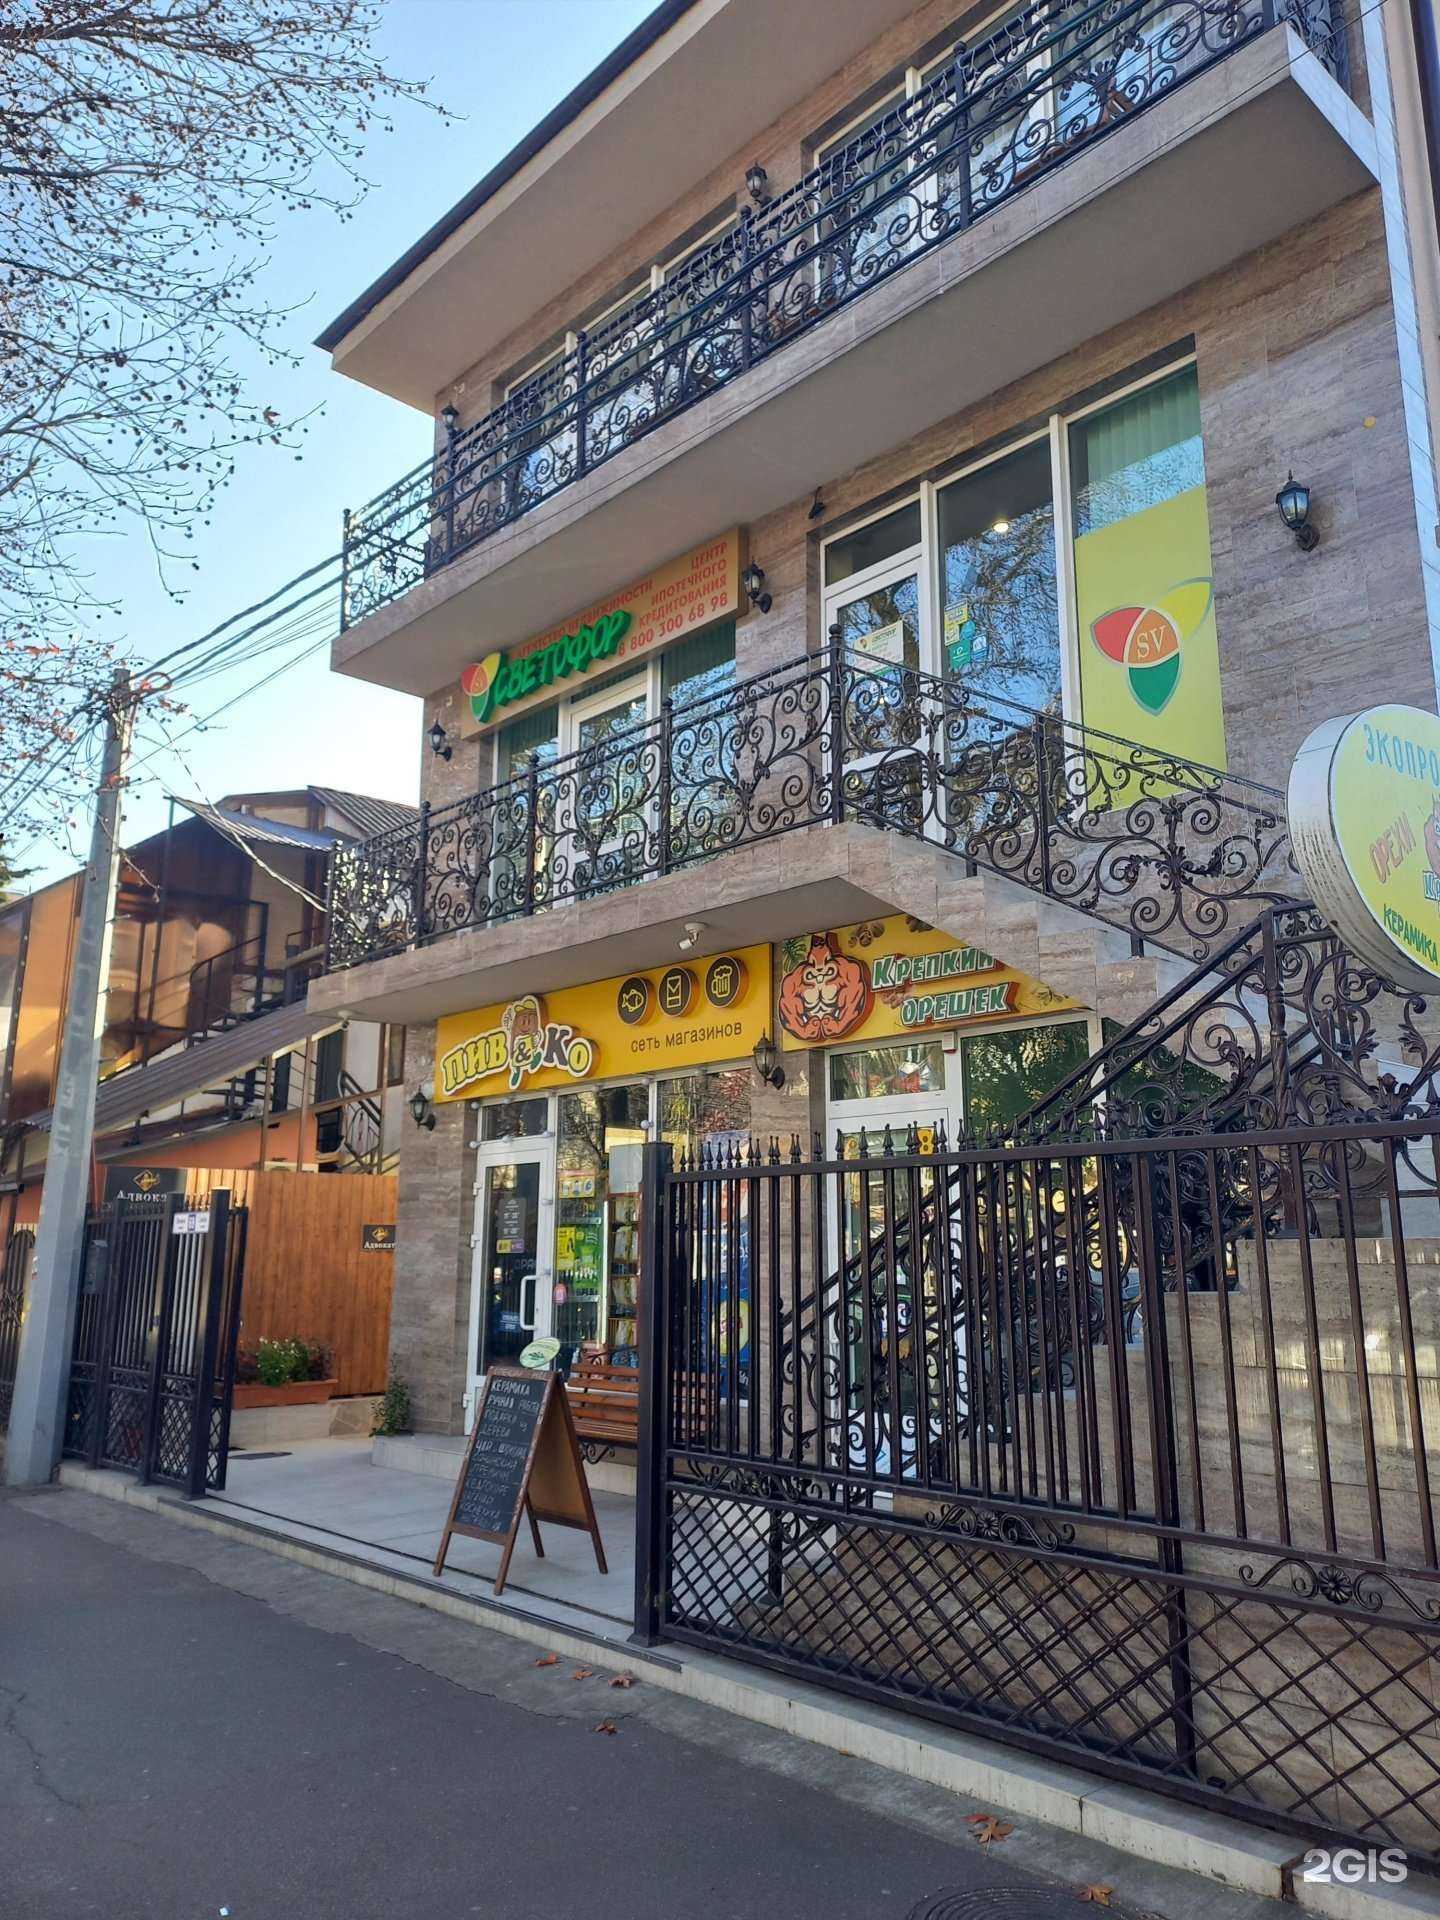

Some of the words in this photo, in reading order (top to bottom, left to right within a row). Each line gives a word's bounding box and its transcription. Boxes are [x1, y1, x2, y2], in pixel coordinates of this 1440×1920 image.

[691, 542, 728, 570] ЦЕНТР
[639, 575, 728, 629] КРЕДИТОВАНИЯ
[651, 559, 727, 606] ИПОТЕЧНОГО
[618, 642, 626, 657] 8
[630, 628, 655, 650] 800
[658, 614, 683, 637] 300
[688, 602, 705, 622] 68
[711, 592, 728, 612] 98
[1136, 625, 1167, 659] SV
[493, 609, 631, 707] СВЕТОФОР
[1369, 811, 1417, 884] ОРЕХИ
[1383, 903, 1438, 966] КЕРАМИКА
[900, 982, 1010, 1027] ОРЕШЕК
[631, 1037, 660, 1053] сеть
[665, 1022, 742, 1048] магазинов
